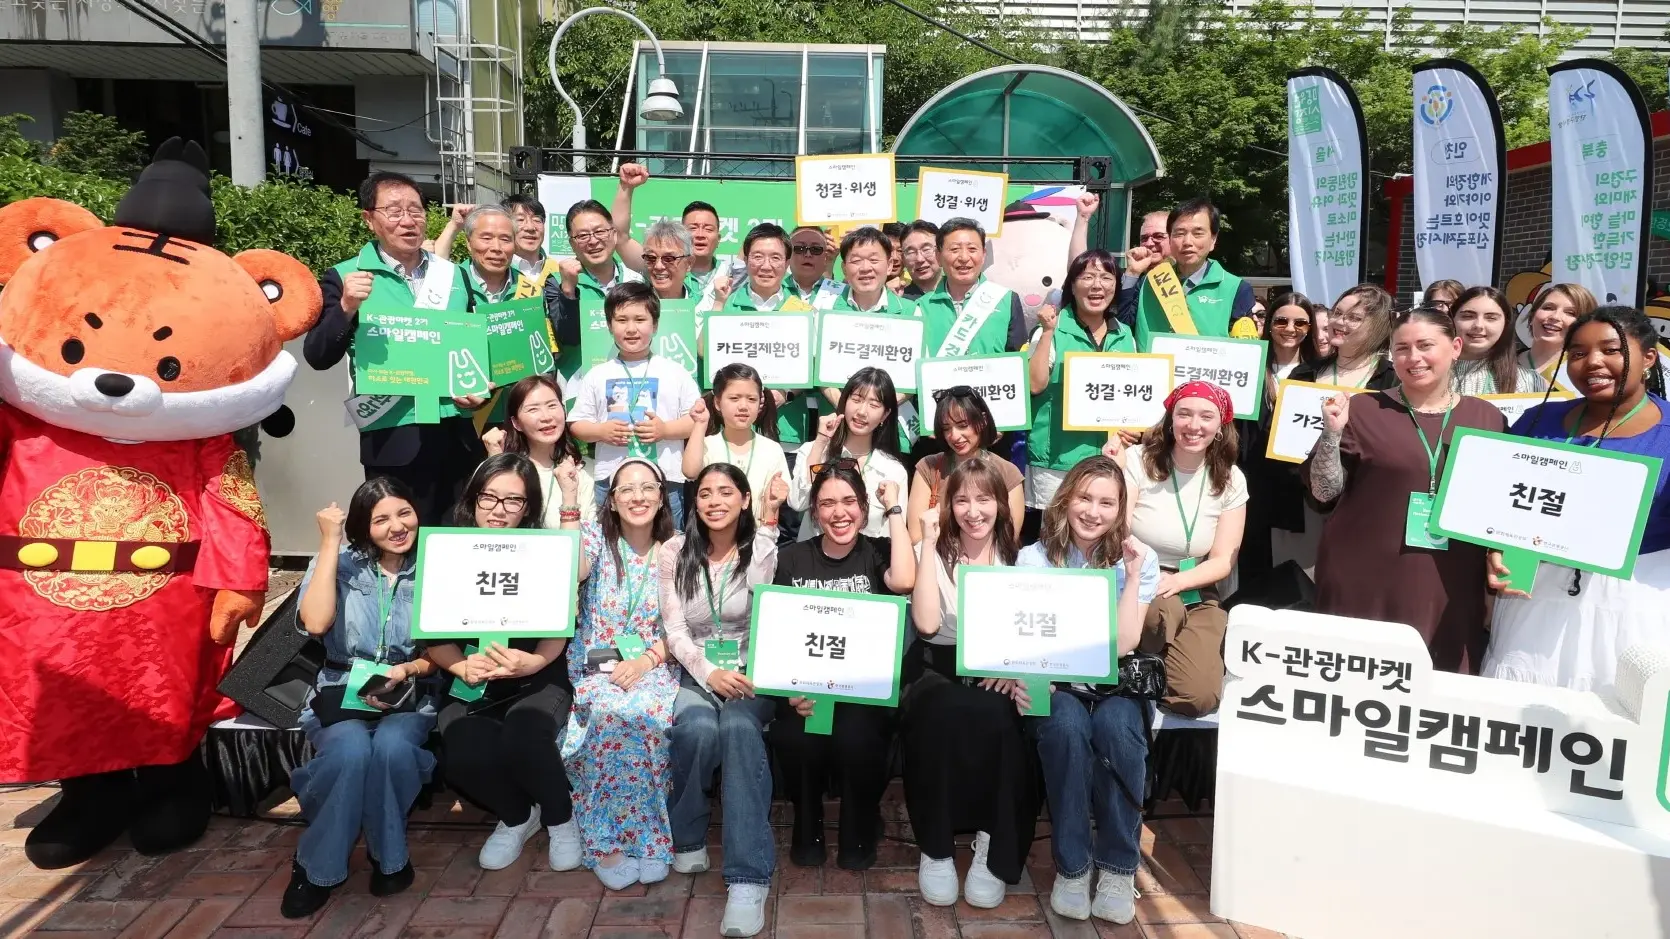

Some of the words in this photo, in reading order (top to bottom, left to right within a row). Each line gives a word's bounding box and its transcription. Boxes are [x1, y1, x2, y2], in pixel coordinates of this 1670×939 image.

[296, 122, 312, 137] Cafe
[414, 318, 429, 326] 2기
[366, 326, 442, 345] 스마일캠페인
[716, 341, 800, 359] 카드결제환영
[829, 340, 914, 363] 카드결제환영
[1173, 365, 1249, 388] 드결제환영
[1511, 452, 1569, 470] 스마일캠페인
[1509, 482, 1567, 517] 친절
[472, 543, 518, 553] 스마일캠페인
[475, 571, 520, 596] 친절
[802, 604, 845, 616] 스마일캠페인
[1013, 610, 1058, 638] 친절
[804, 632, 847, 660] 친절
[1242, 640, 1413, 694] K-관광마켓
[1235, 684, 1629, 801] 스마일캠페인
